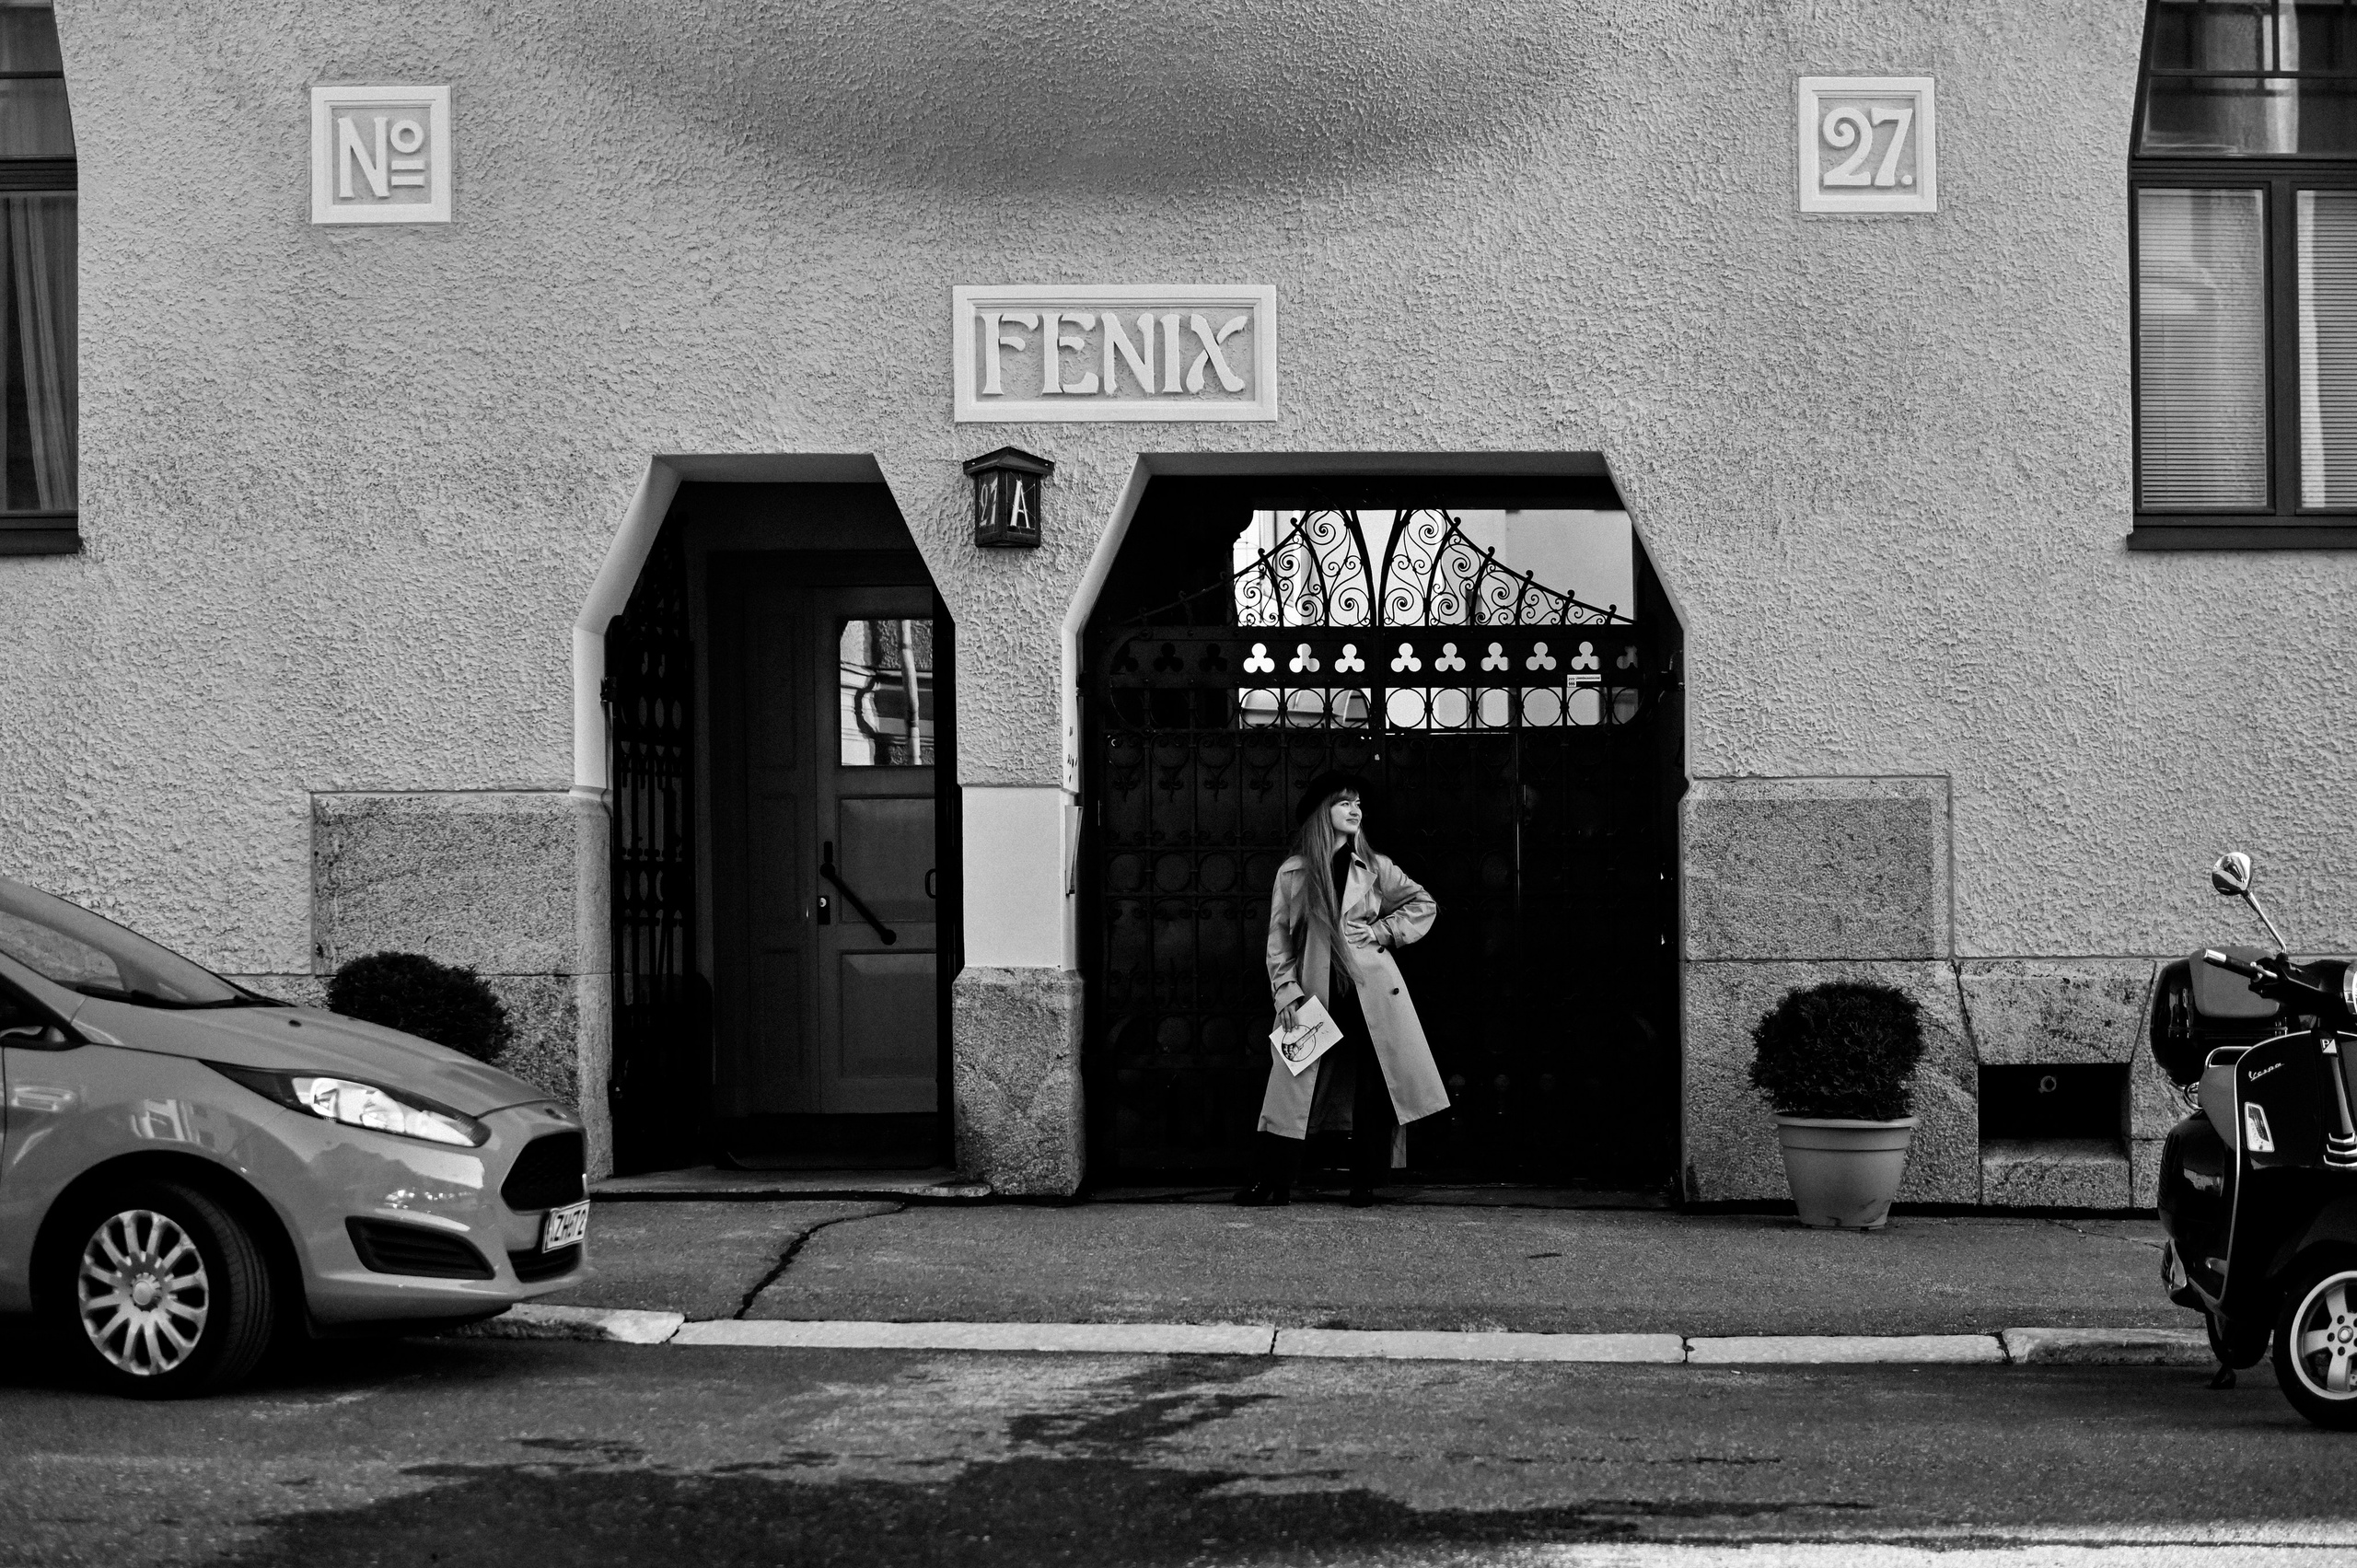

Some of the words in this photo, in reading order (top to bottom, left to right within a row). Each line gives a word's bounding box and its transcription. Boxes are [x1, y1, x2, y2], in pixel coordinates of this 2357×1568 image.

[1823, 107, 1913, 187] 27.
[980, 313, 1248, 395] FENIX
[1010, 479, 1030, 528] A
[2248, 1063, 2283, 1081] Vespa
